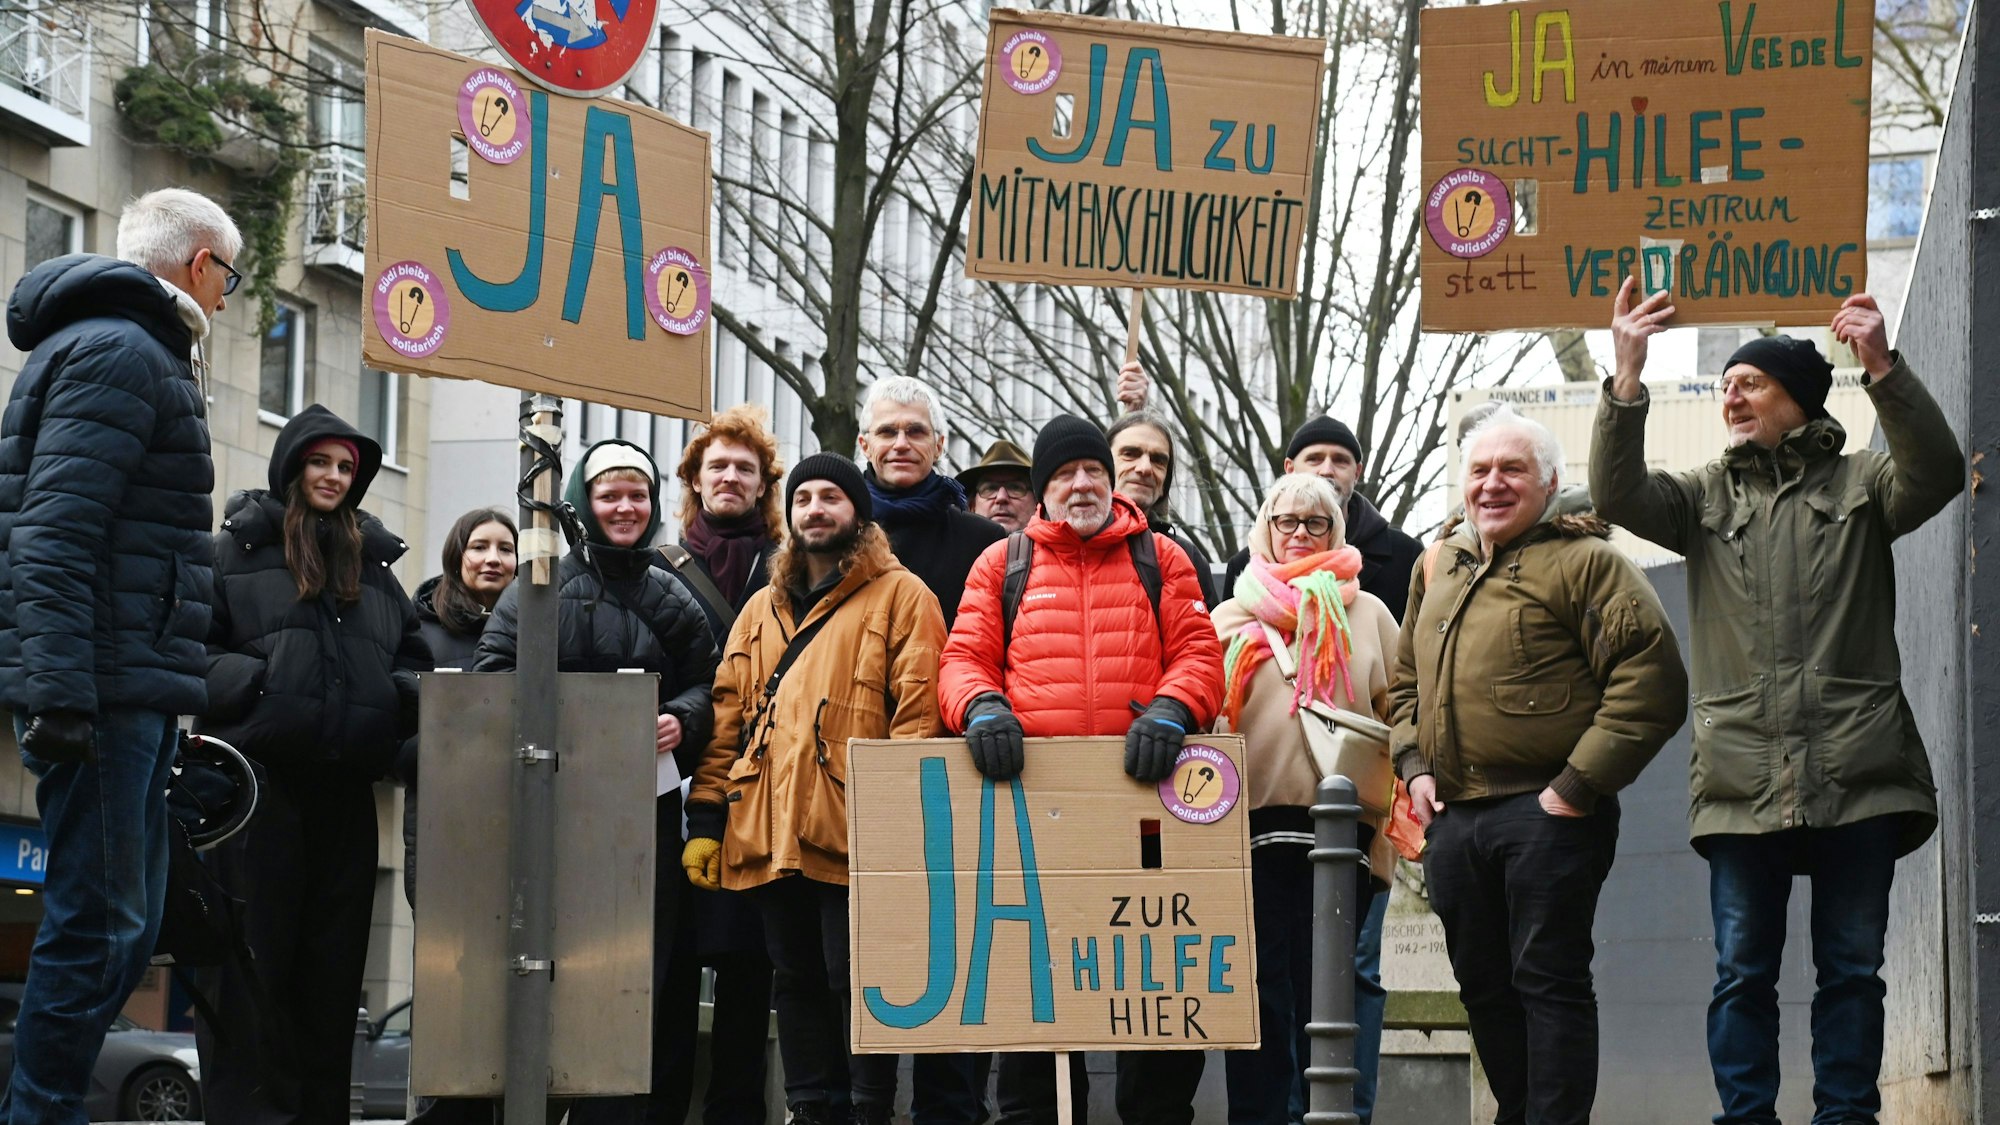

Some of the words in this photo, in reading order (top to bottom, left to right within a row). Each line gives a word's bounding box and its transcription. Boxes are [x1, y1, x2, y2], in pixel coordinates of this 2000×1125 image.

[1003, 34, 1020, 54] Südi
[1020, 31, 1046, 44] bleibt
[1482, 9, 1576, 108] JA
[1590, 53, 1634, 82] in
[1640, 55, 1718, 77] meinem
[466, 71, 487, 93] Südi
[487, 71, 518, 99] bleibt
[1013, 69, 1057, 91] solidarisch
[1026, 43, 1172, 171] JA
[470, 134, 523, 160] solidarisch
[1430, 180, 1450, 208] Südi
[1449, 170, 1486, 185] bleibt
[445, 90, 645, 341] JA
[1644, 193, 1799, 230] ZENTRUM
[1450, 218, 1508, 253] solidarisch
[667, 249, 695, 271] bleibt
[1445, 253, 1537, 299] statt
[378, 267, 398, 294] Südi
[398, 264, 430, 284] bleibt
[658, 308, 705, 332] solidarisch
[391, 324, 445, 353] solidarisch
[1190, 747, 1224, 766] bleibt
[1172, 799, 1231, 821] solidarisch
[863, 756, 1055, 1029] JA
[1109, 893, 1197, 927] ZUR
[1071, 933, 1236, 994] HILFE
[1109, 997, 1208, 1039] HIER
